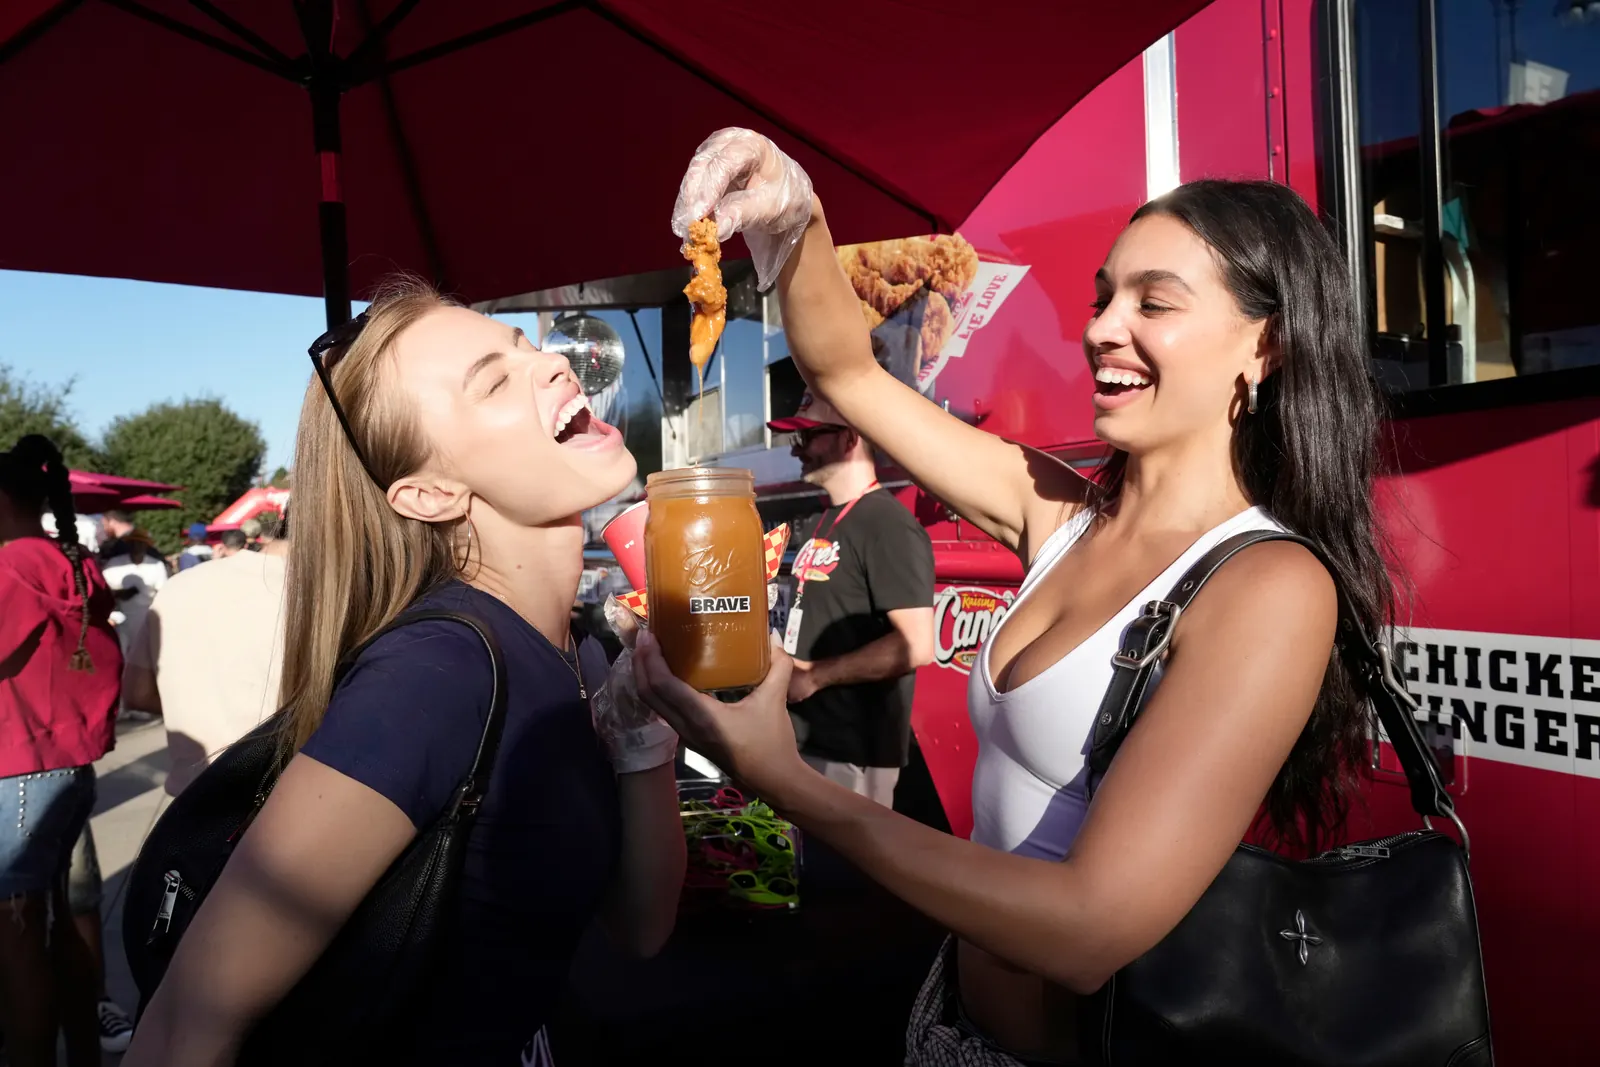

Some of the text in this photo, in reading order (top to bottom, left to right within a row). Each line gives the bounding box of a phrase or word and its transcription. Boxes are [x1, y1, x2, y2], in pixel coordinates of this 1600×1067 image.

[976, 273, 1008, 310] LOVE
[690, 597, 750, 613] BRAVE
[962, 593, 996, 613] Raising
